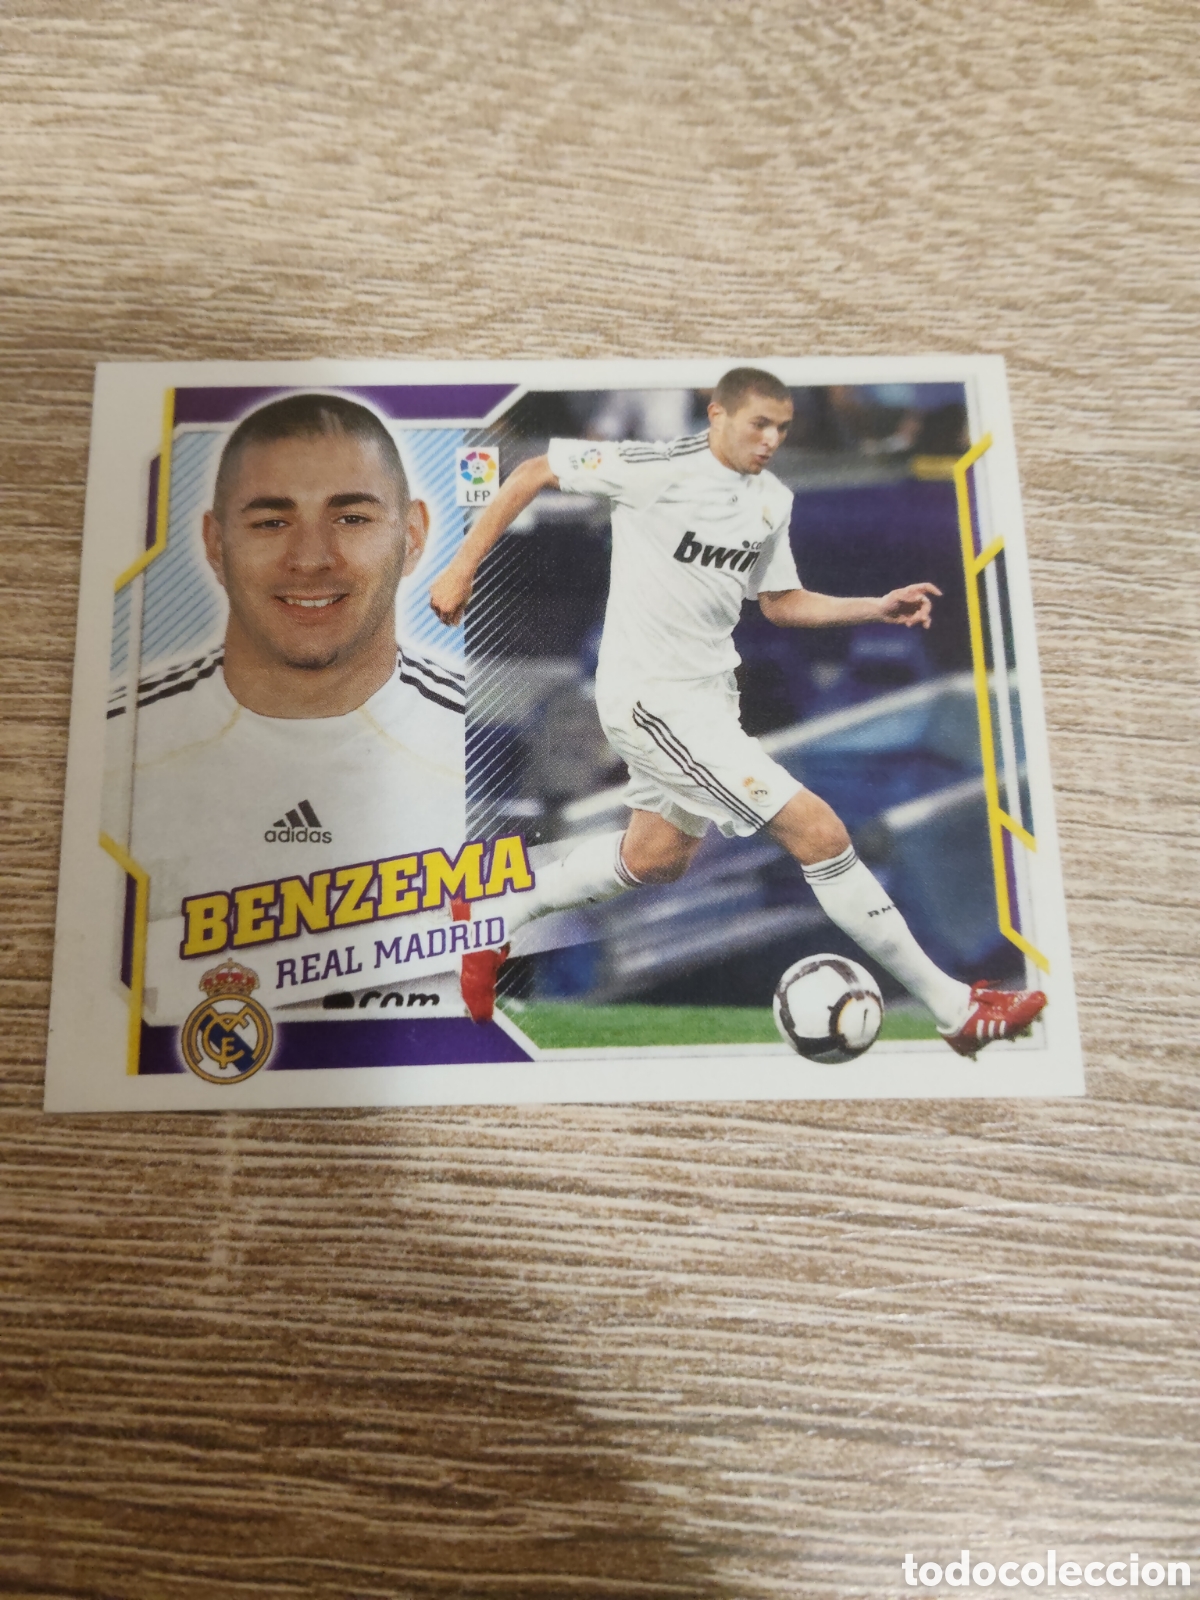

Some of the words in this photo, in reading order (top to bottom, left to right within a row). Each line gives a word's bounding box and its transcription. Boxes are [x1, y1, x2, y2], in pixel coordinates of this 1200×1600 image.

[466, 490, 491, 503] LFP
[264, 826, 333, 844] adidas
[180, 833, 536, 960] BENZEMA
[275, 945, 363, 989] REAL
[374, 916, 506, 969] MADRID
